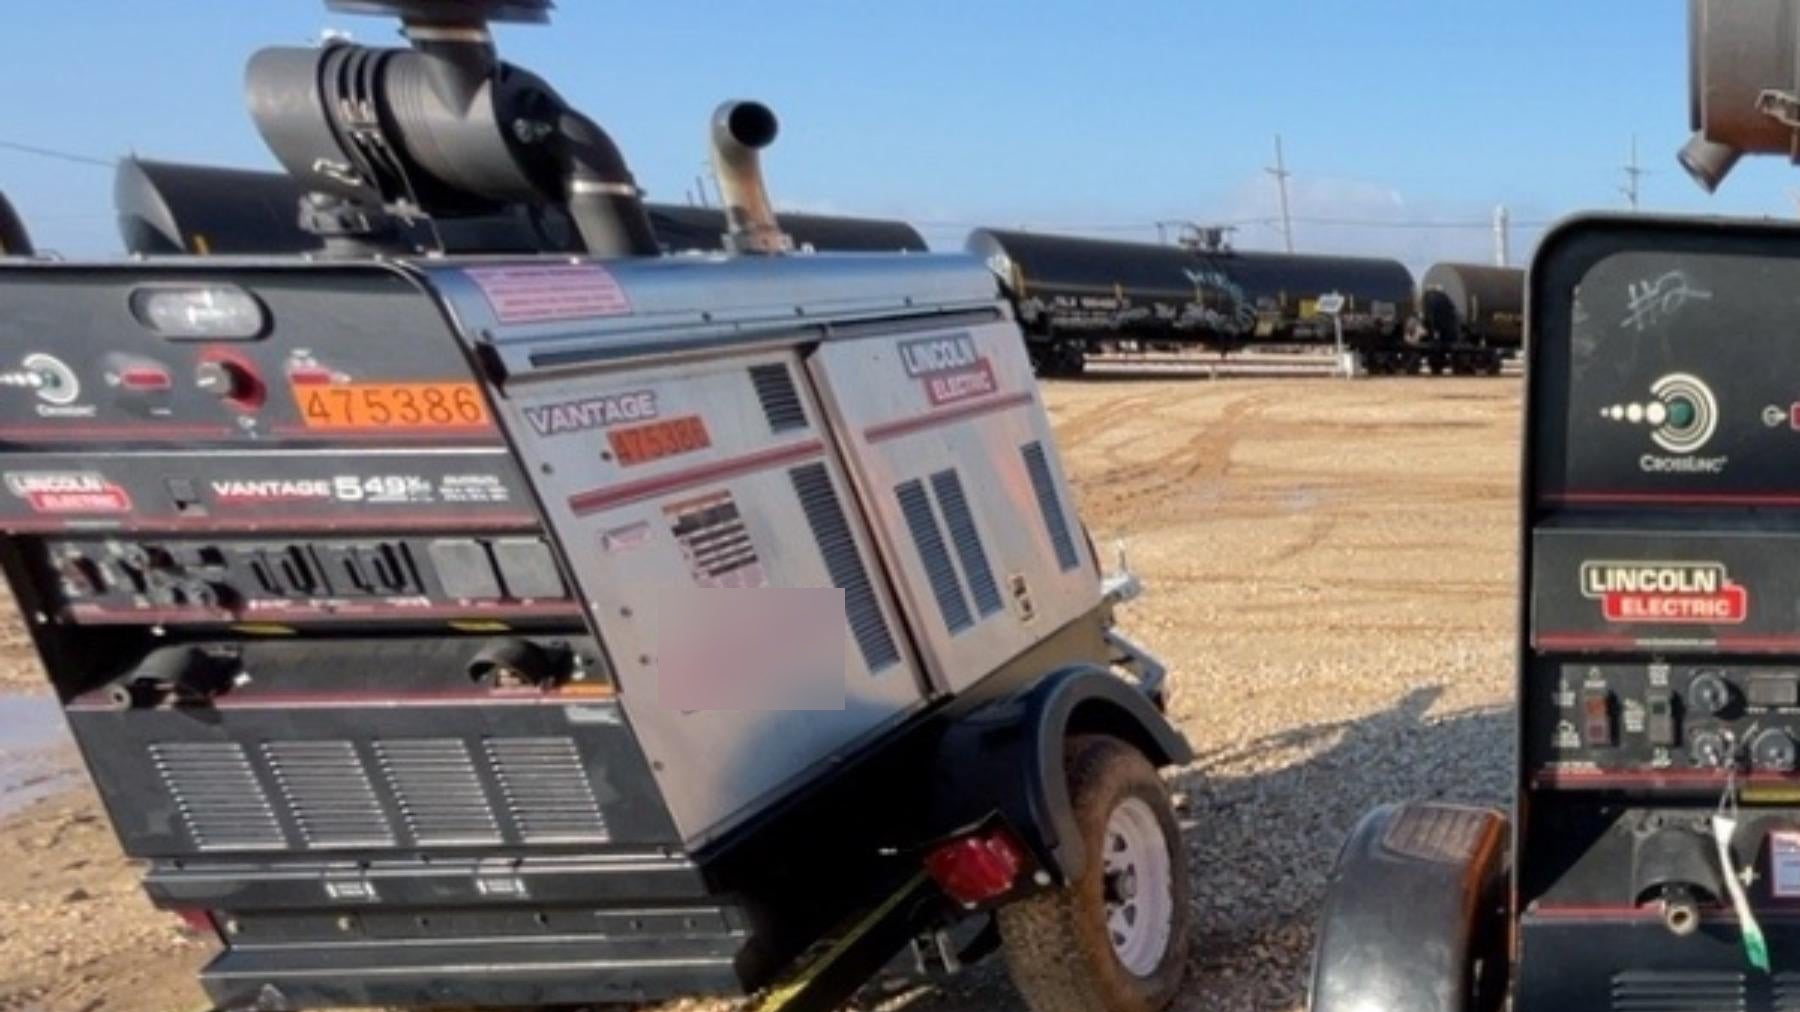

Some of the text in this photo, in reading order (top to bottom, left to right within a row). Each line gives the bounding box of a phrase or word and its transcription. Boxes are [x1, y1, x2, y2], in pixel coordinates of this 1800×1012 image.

[306, 386, 481, 425] 475386
[525, 391, 658, 436] VANTAGE
[211, 480, 330, 496] VANTAGE
[1589, 567, 1717, 593] LINCOLN
[1619, 597, 1731, 617] ELECTRIC
